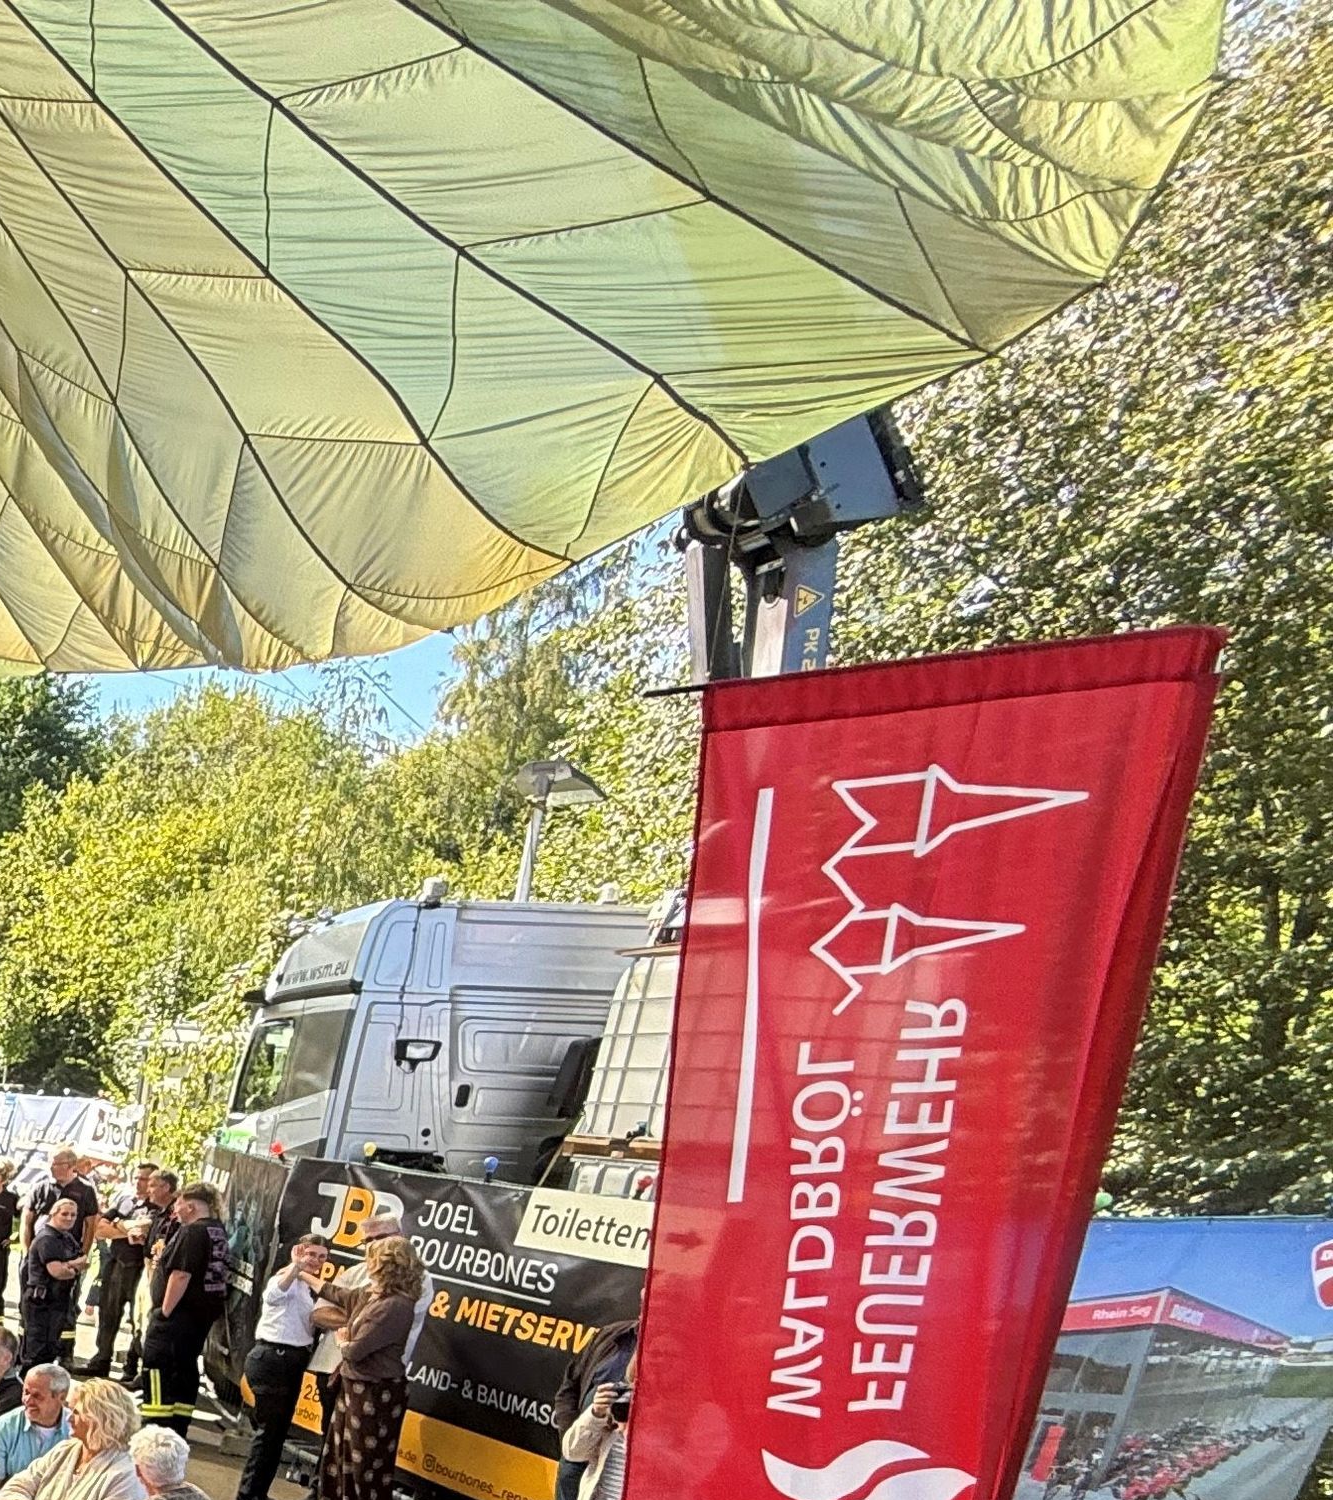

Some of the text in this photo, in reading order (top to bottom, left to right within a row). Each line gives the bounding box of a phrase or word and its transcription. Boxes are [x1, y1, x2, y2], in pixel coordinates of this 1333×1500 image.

[418, 1200, 478, 1236] JOEL
[531, 1203, 651, 1250] Toiletten
[429, 1291, 599, 1354] & MIETSERV
[461, 1379, 473, 1399] &
